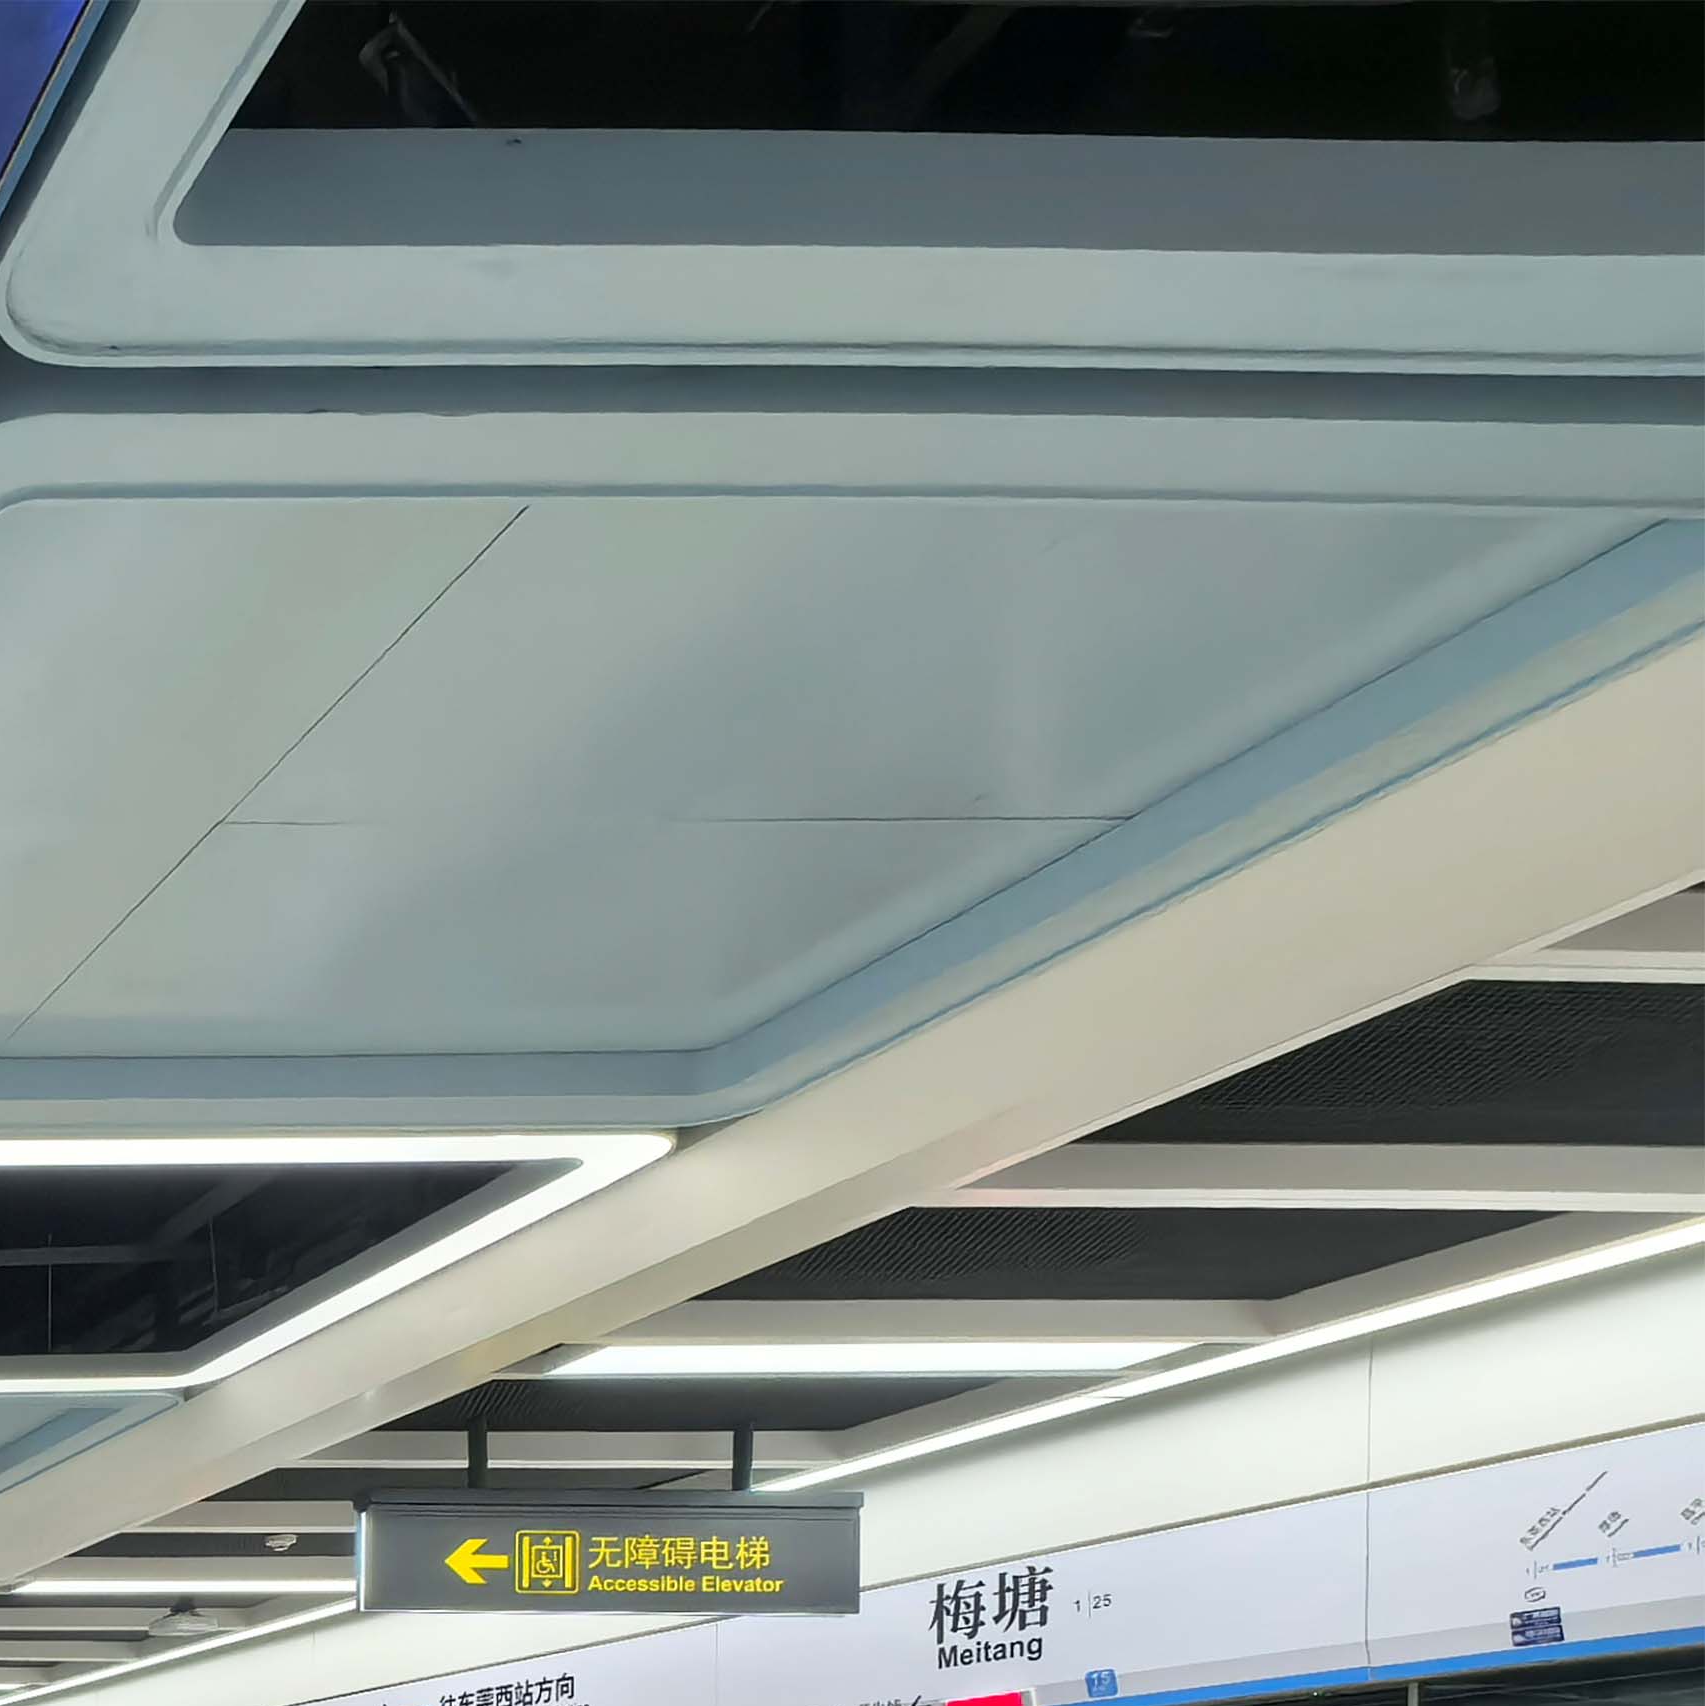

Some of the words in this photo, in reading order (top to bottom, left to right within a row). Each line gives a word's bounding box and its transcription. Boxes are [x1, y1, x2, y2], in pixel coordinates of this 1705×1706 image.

[588, 1535, 771, 1570] 无障碍电梯
[588, 1576, 695, 1592] Accessible
[701, 1576, 784, 1592] Elevator
[928, 1566, 1054, 1645] 梅塘
[938, 1637, 1043, 1669] Meitang
